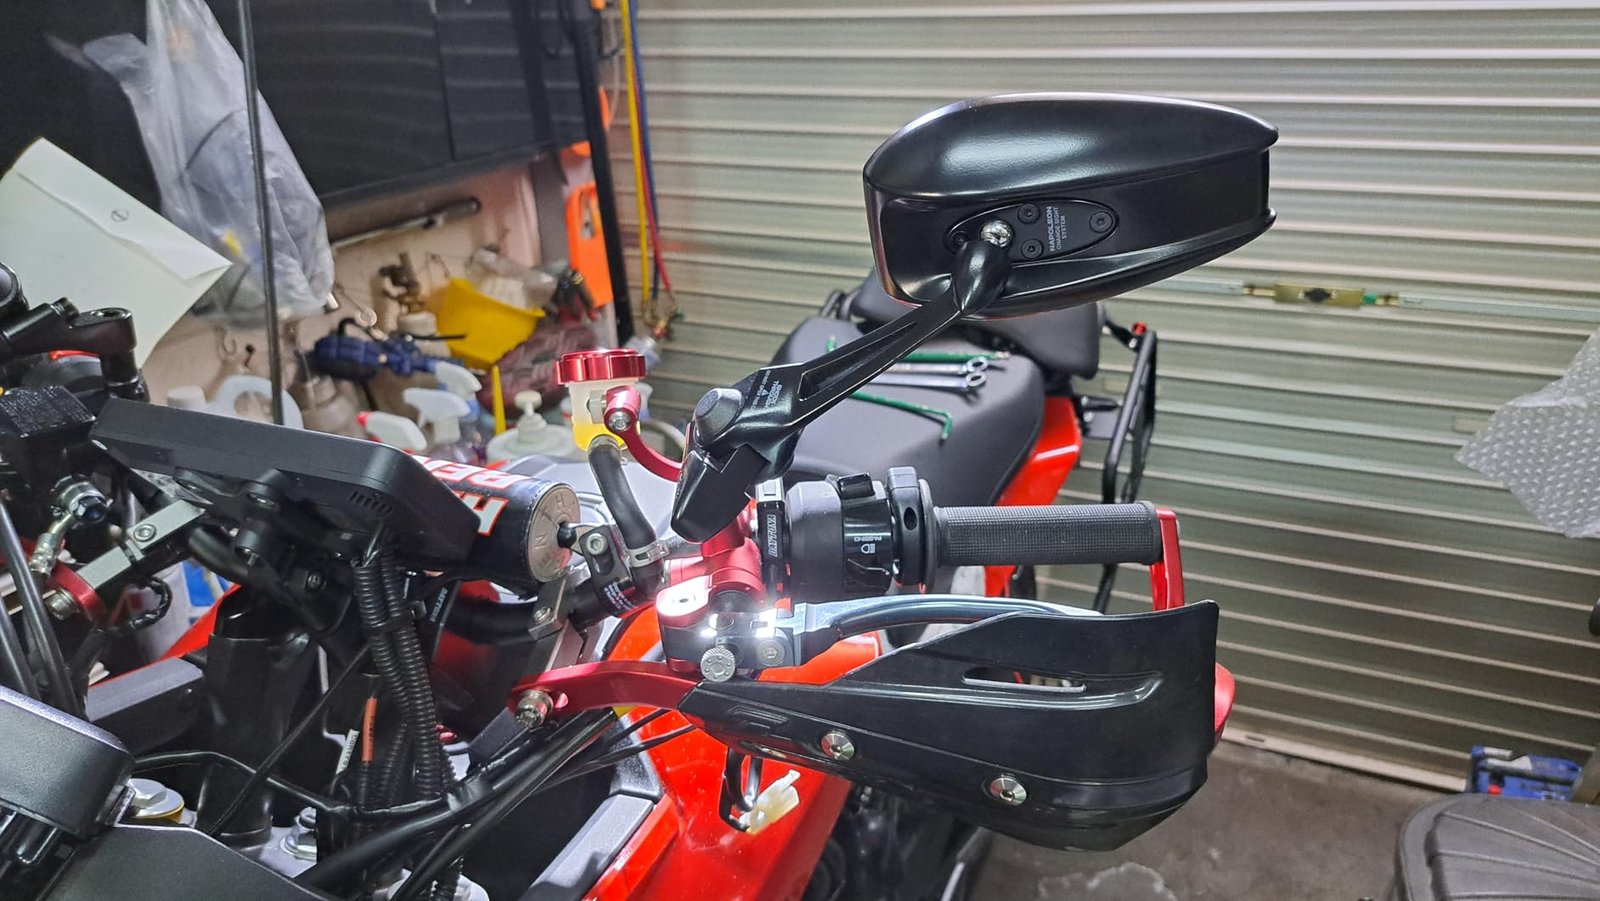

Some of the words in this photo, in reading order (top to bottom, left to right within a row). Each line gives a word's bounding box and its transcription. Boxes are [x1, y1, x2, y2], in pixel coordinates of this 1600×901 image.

[1046, 206, 1055, 252] NAPOLEON
[1054, 225, 1062, 250] CHANGE
[767, 514, 778, 558] DAYTONA
[342, 734, 358, 768] Contro
